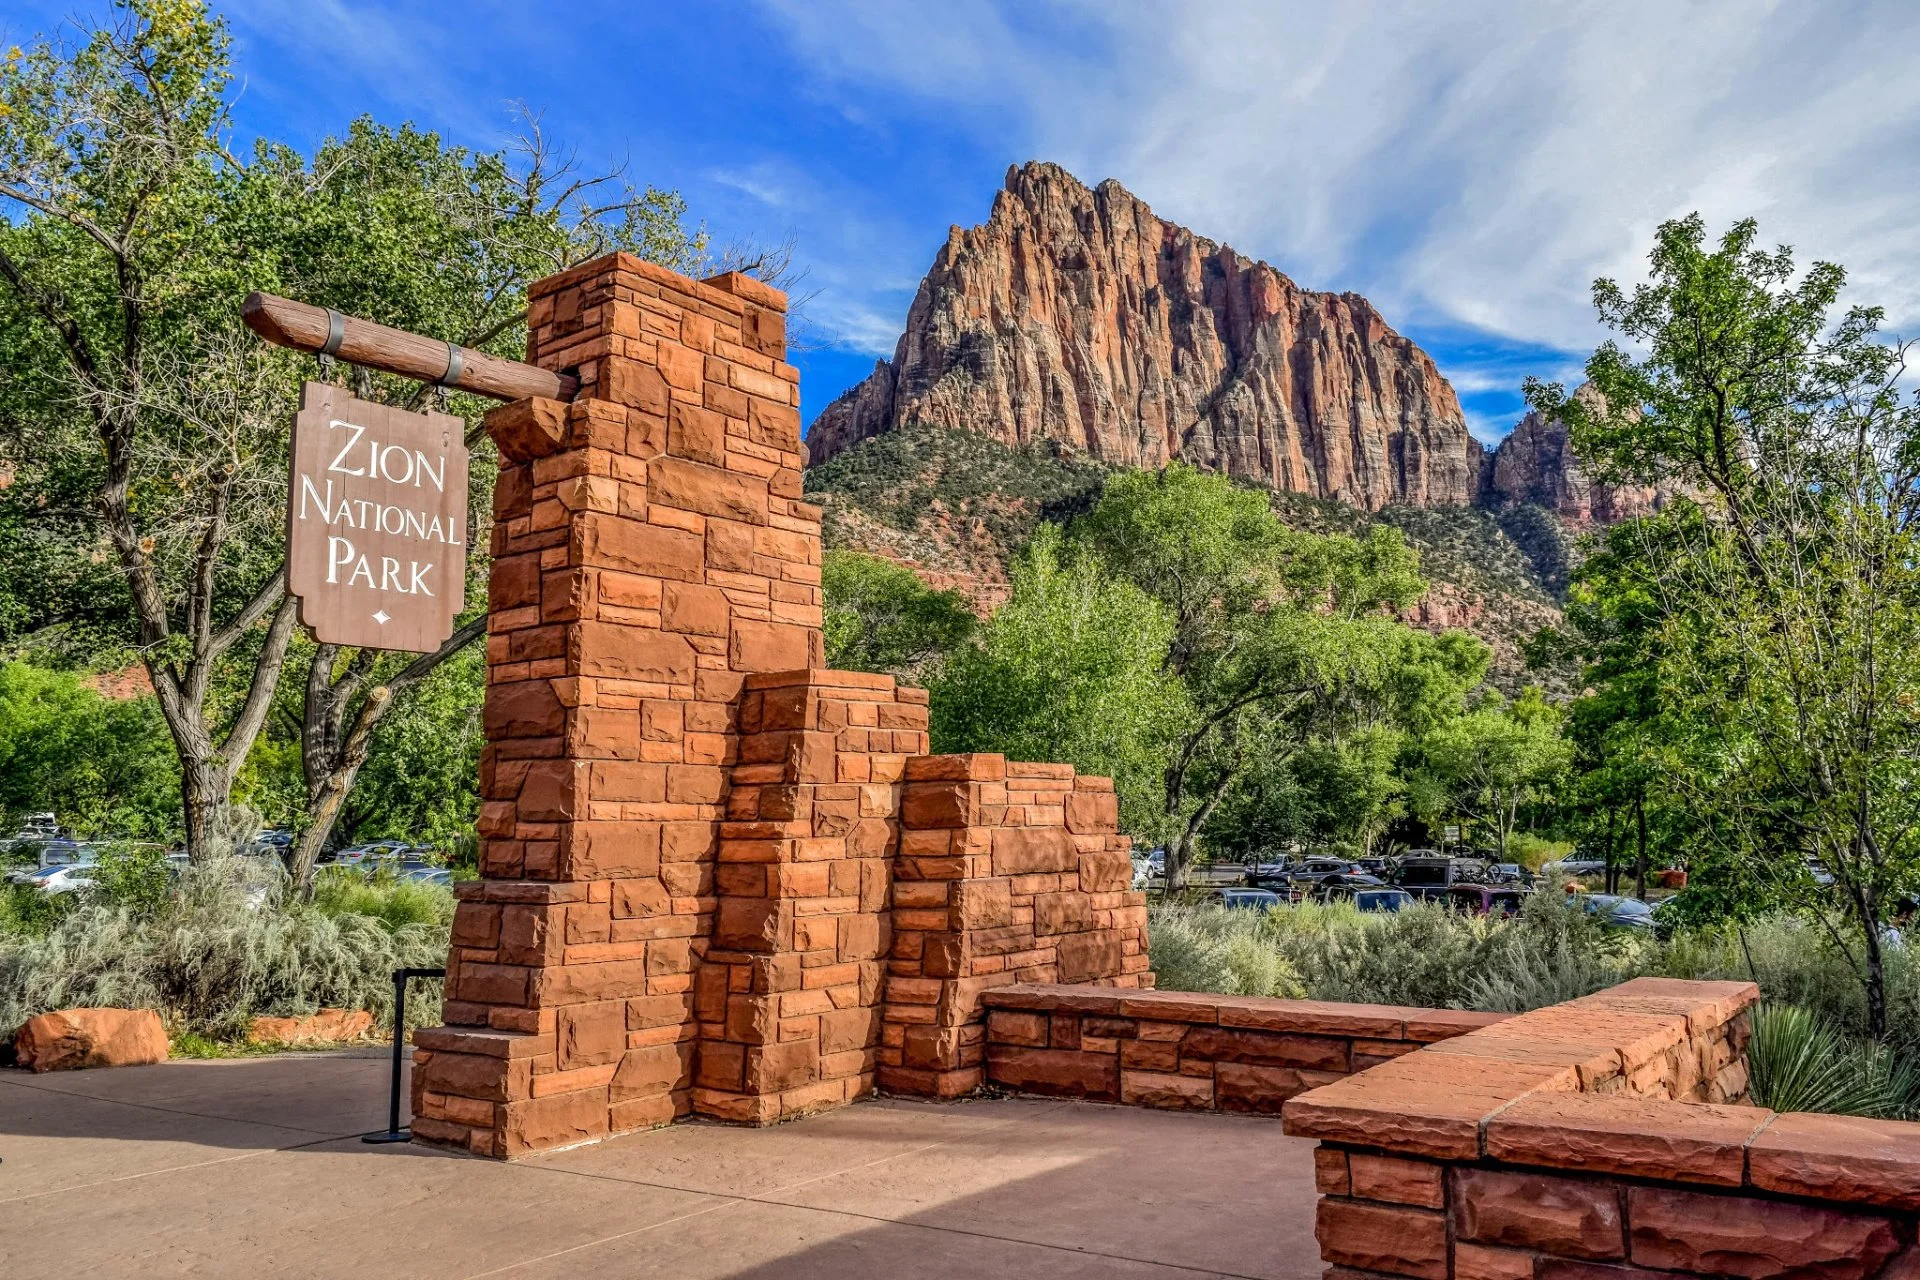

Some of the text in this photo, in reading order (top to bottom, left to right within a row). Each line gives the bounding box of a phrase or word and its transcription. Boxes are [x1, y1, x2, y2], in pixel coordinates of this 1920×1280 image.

[328, 420, 445, 492] ZION
[299, 473, 461, 545] NATIONAL
[326, 536, 435, 597] PARK
